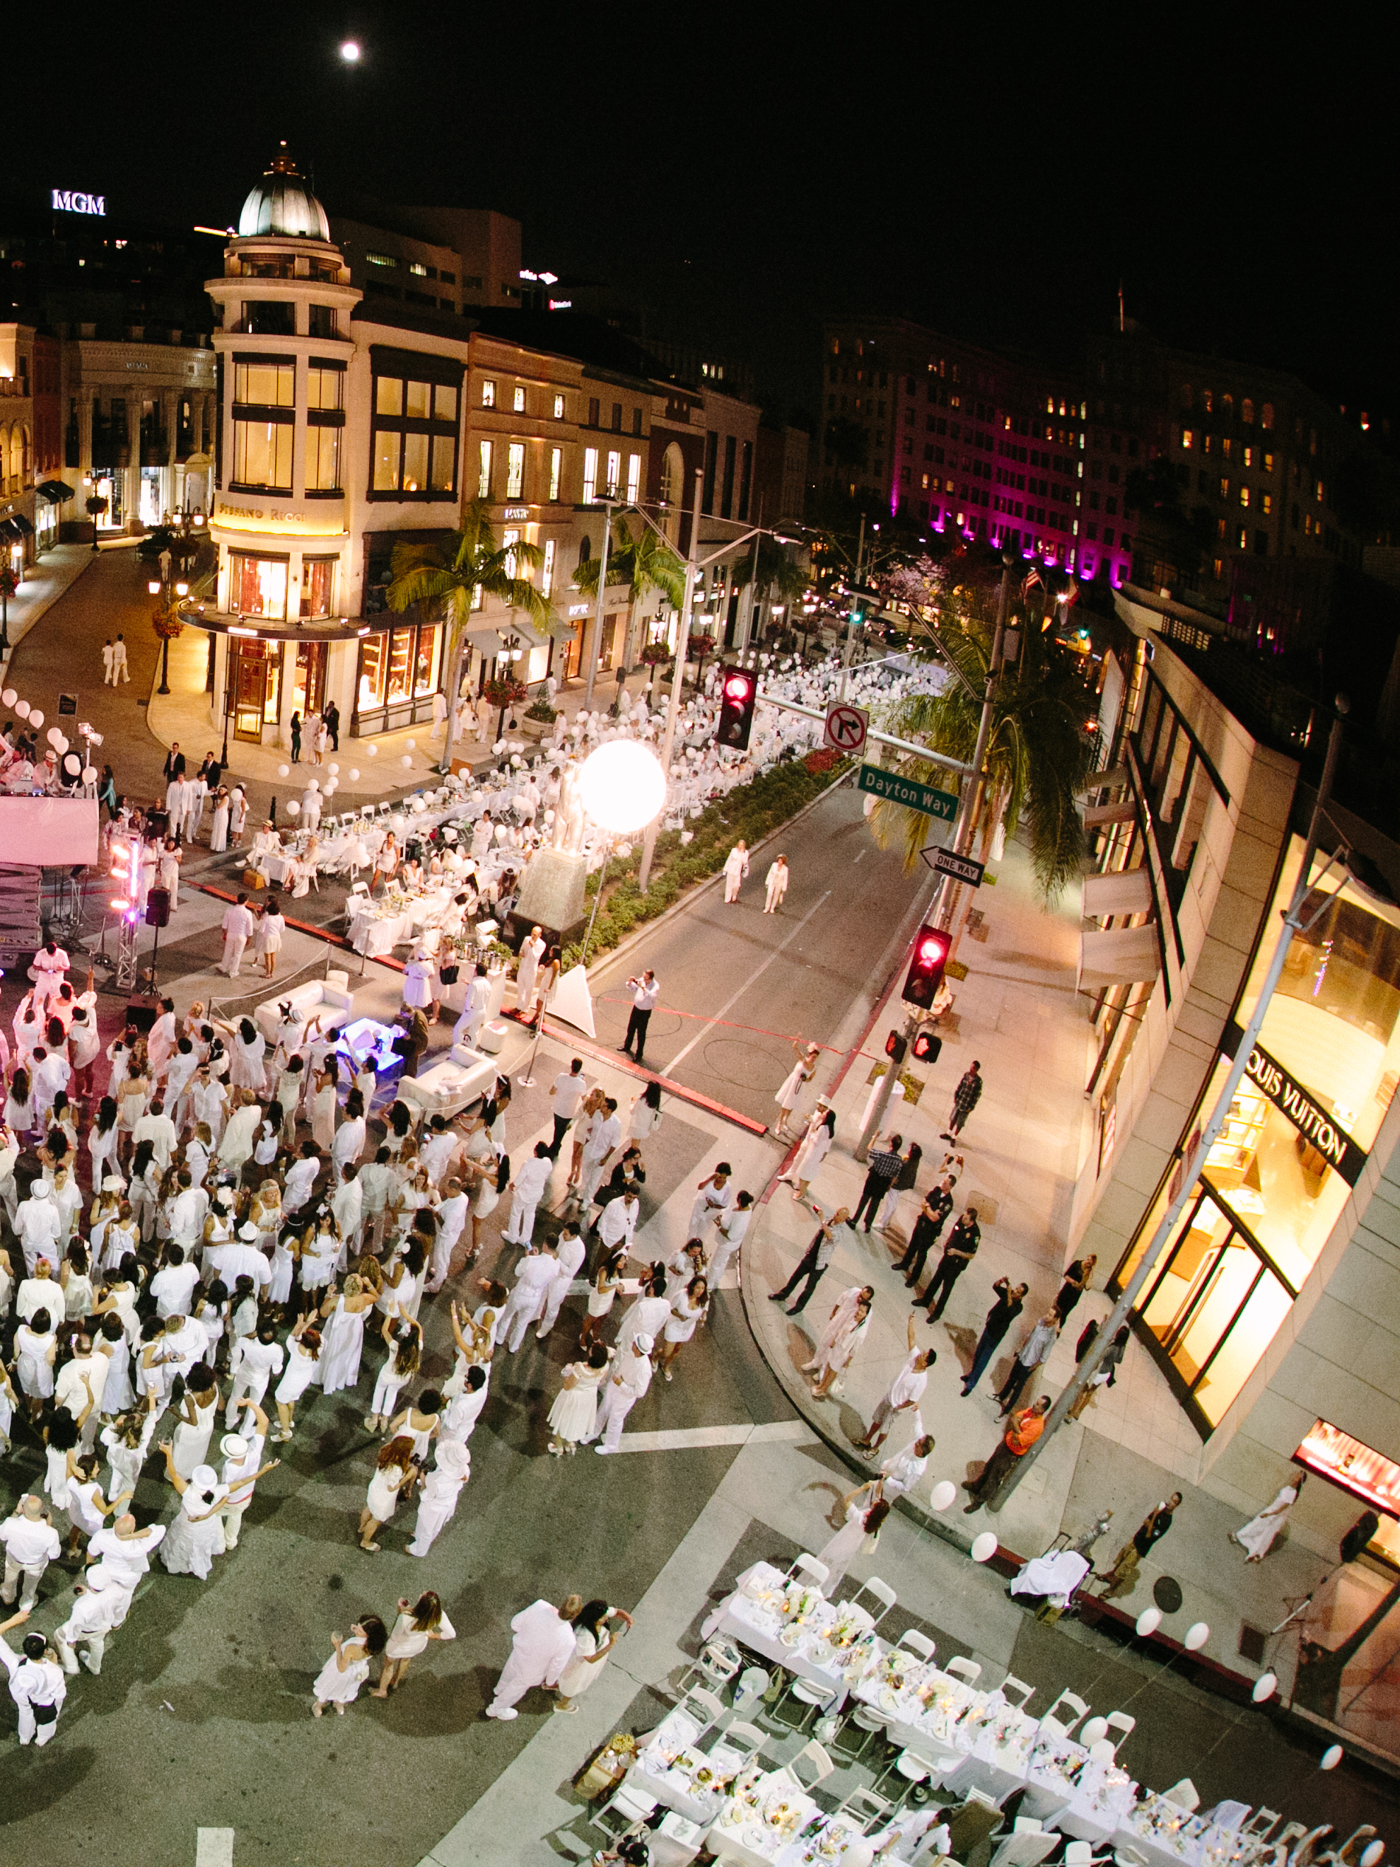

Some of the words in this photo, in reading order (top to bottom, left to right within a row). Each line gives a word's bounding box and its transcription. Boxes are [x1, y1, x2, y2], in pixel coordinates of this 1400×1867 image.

[52, 189, 106, 216] MGM
[219, 503, 263, 519] STEFANO
[271, 509, 305, 522] RICCI
[866, 772, 917, 802] Dayton
[922, 792, 950, 817] Way
[937, 855, 955, 870] ONE
[957, 862, 977, 878] WAY
[1246, 1049, 1283, 1097] OUIS
[1283, 1082, 1347, 1165] VUITTON
